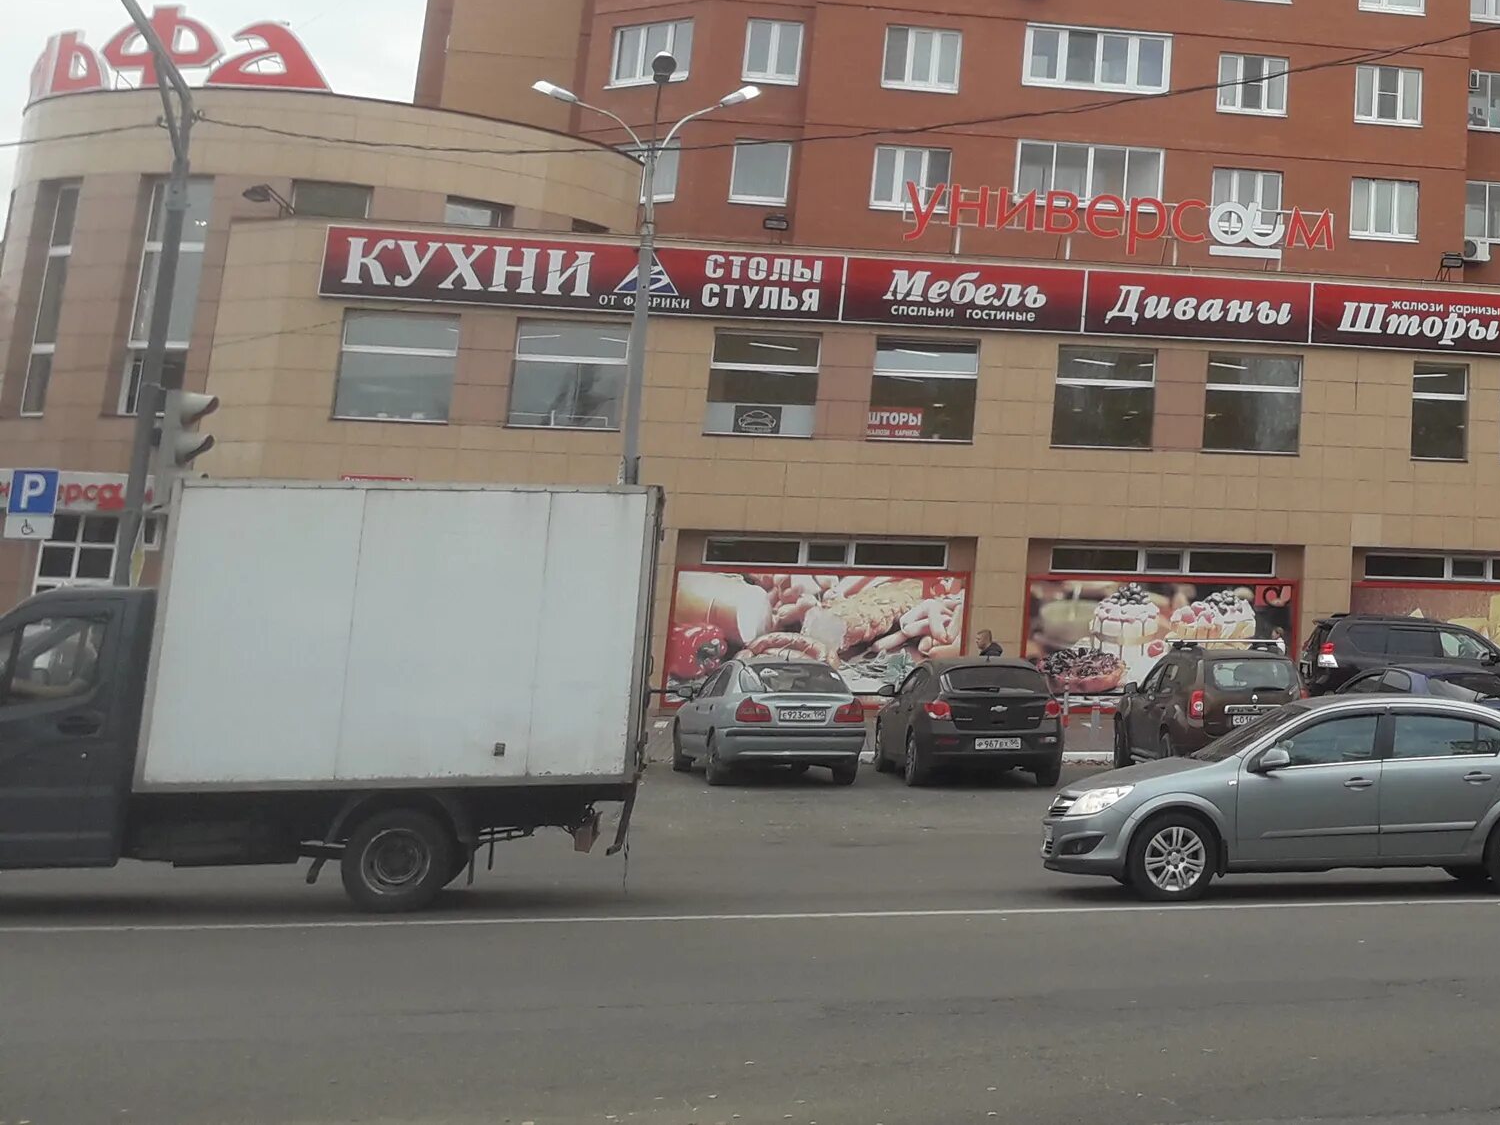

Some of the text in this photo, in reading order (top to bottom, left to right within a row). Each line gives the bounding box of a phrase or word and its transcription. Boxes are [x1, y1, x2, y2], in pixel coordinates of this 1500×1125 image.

[341, 236, 596, 297] КУХНИ
[705, 254, 823, 283] СТОЛЫ
[599, 294, 691, 310] ОТ ФБРИКИ
[701, 283, 820, 312] СТУЛЬЯ
[882, 269, 1047, 308] Мебель
[890, 304, 1036, 322] спальни гостиные
[1104, 285, 1291, 325] Диваны
[1391, 300, 1500, 317] жалюзи карнизы
[1337, 301, 1500, 346] Шторы
[868, 411, 922, 426] ШТОРЫ
